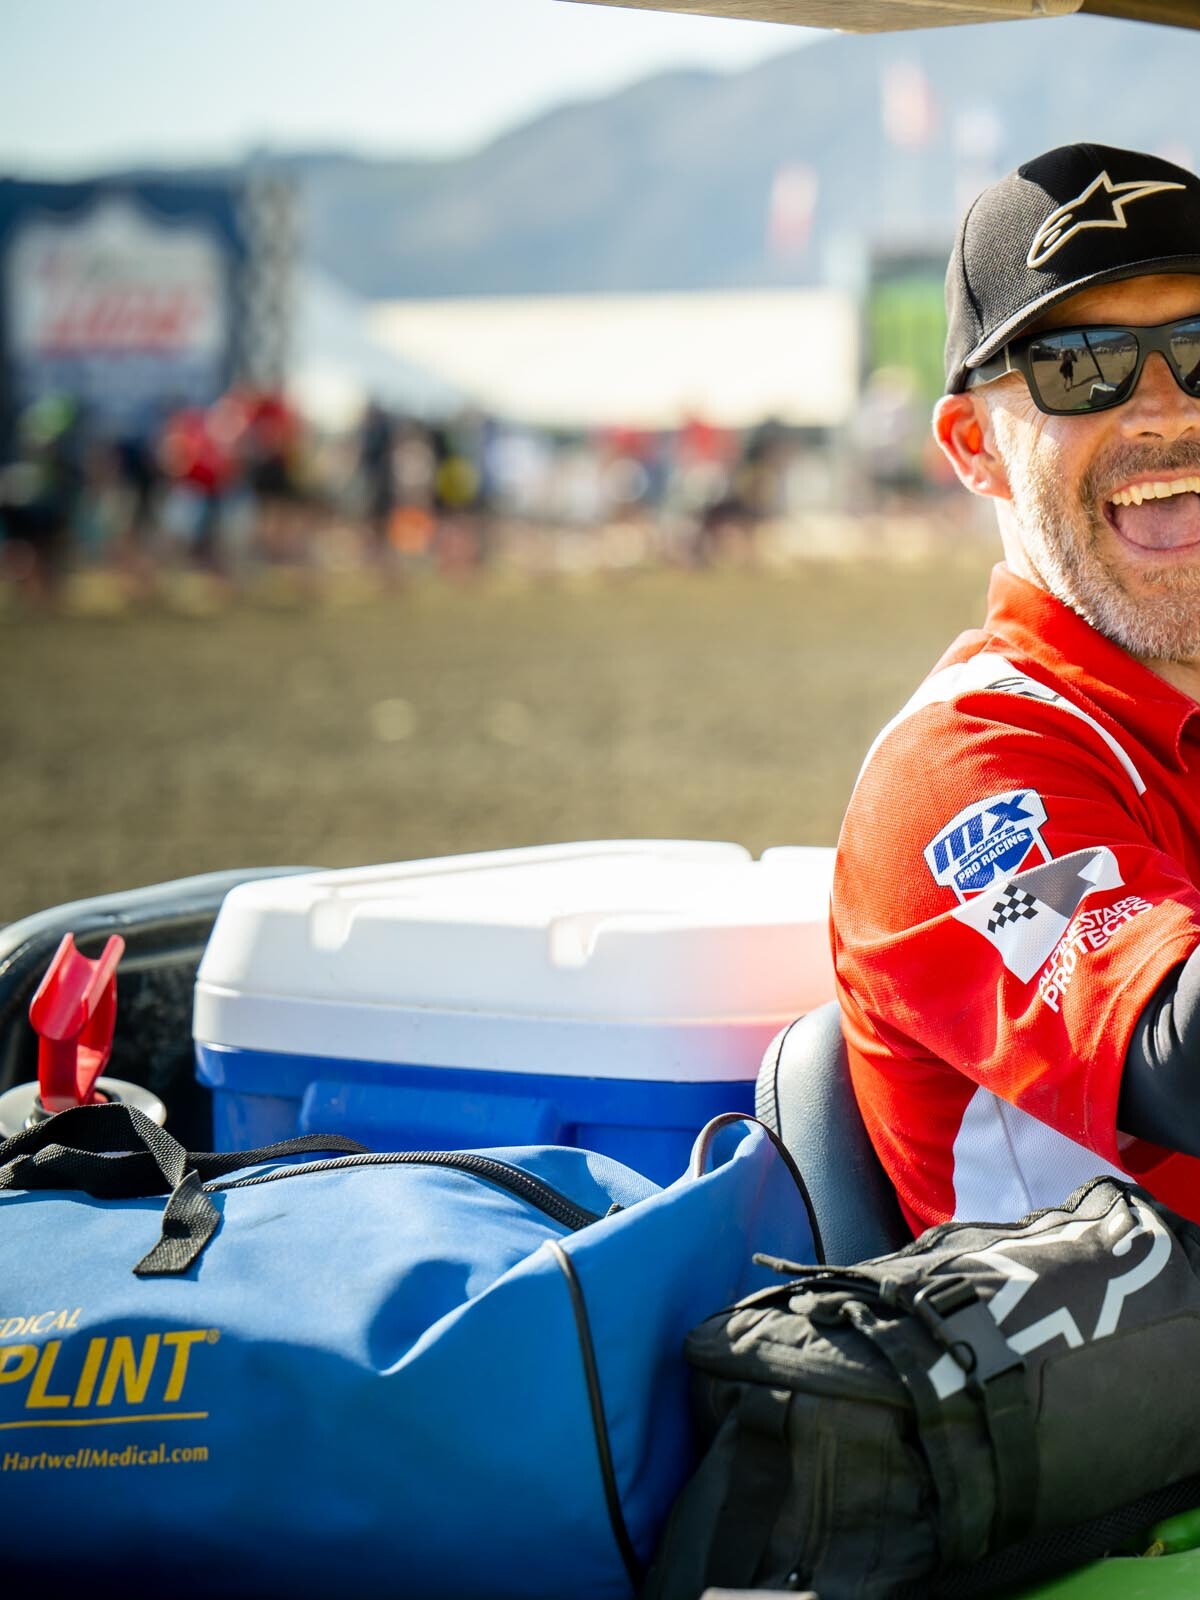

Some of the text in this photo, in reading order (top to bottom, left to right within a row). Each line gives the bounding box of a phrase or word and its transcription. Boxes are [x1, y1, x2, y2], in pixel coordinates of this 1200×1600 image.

[957, 831, 1029, 885] PRO RACING
[958, 825, 1016, 868] SPORTS
[1038, 895, 1142, 996] ALPINESTARS
[1041, 899, 1154, 1014] PROTECTS
